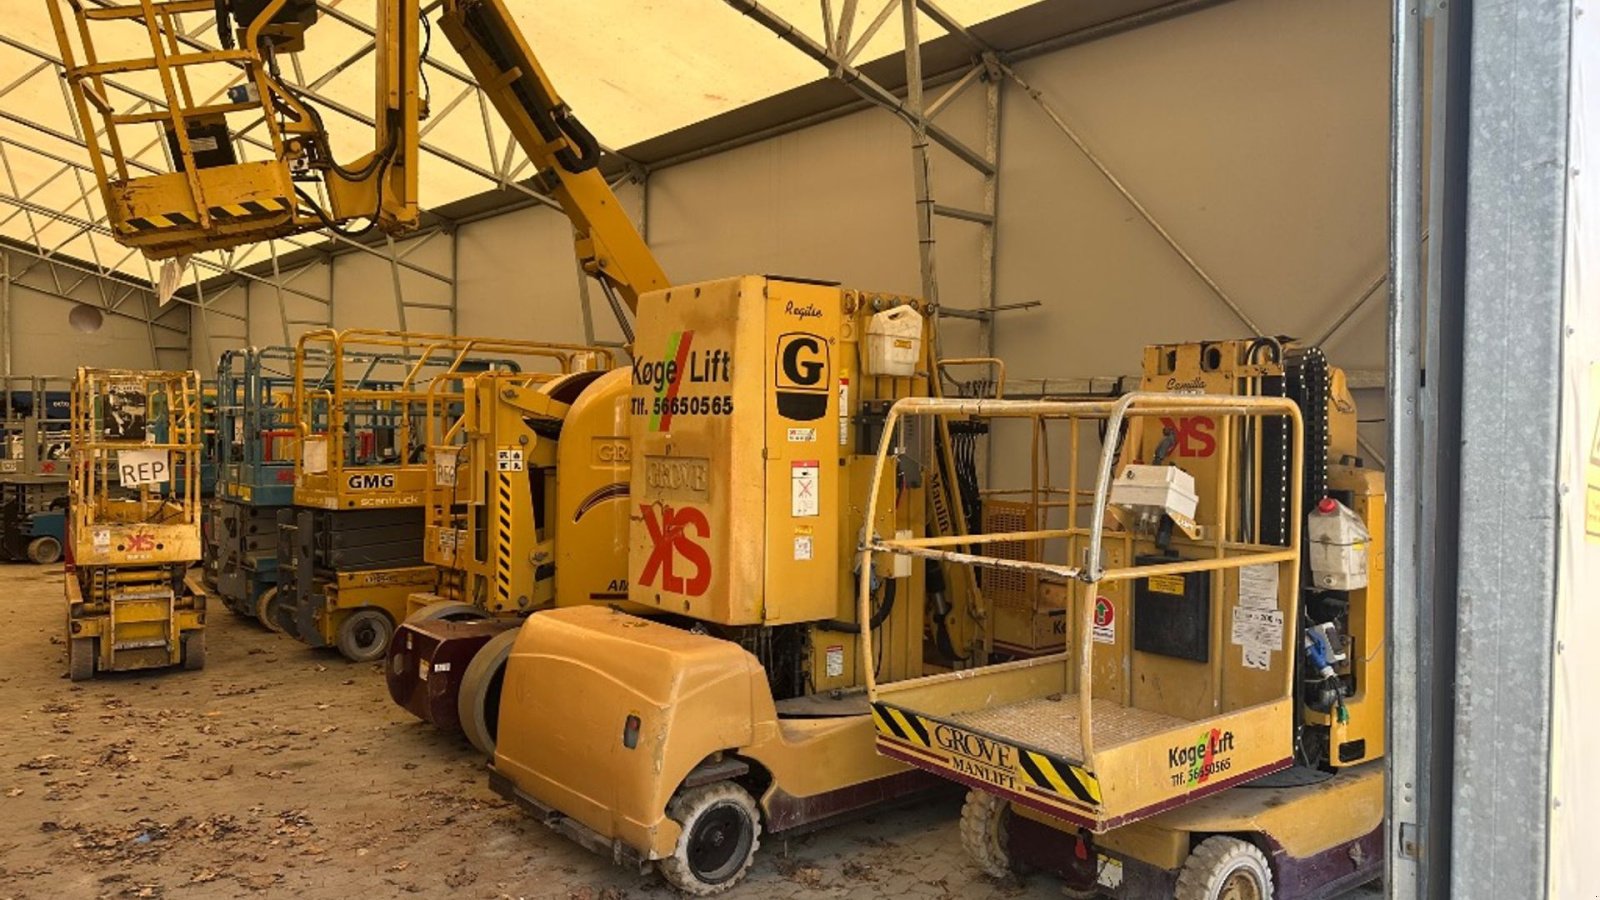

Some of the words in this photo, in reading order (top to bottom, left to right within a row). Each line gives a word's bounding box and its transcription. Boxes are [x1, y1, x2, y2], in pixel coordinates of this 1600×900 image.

[631, 355, 678, 393] Køge
[690, 349, 731, 383] Lift
[782, 337, 825, 386] G
[653, 395, 734, 415] 56650565
[121, 460, 166, 485] REP
[348, 474, 394, 489] GMG
[649, 461, 707, 491] GROVE
[934, 724, 1013, 771] GROVE
[1168, 743, 1206, 769] Køge
[1210, 731, 1235, 756] Lift
[952, 756, 1017, 790] MANLIFT
